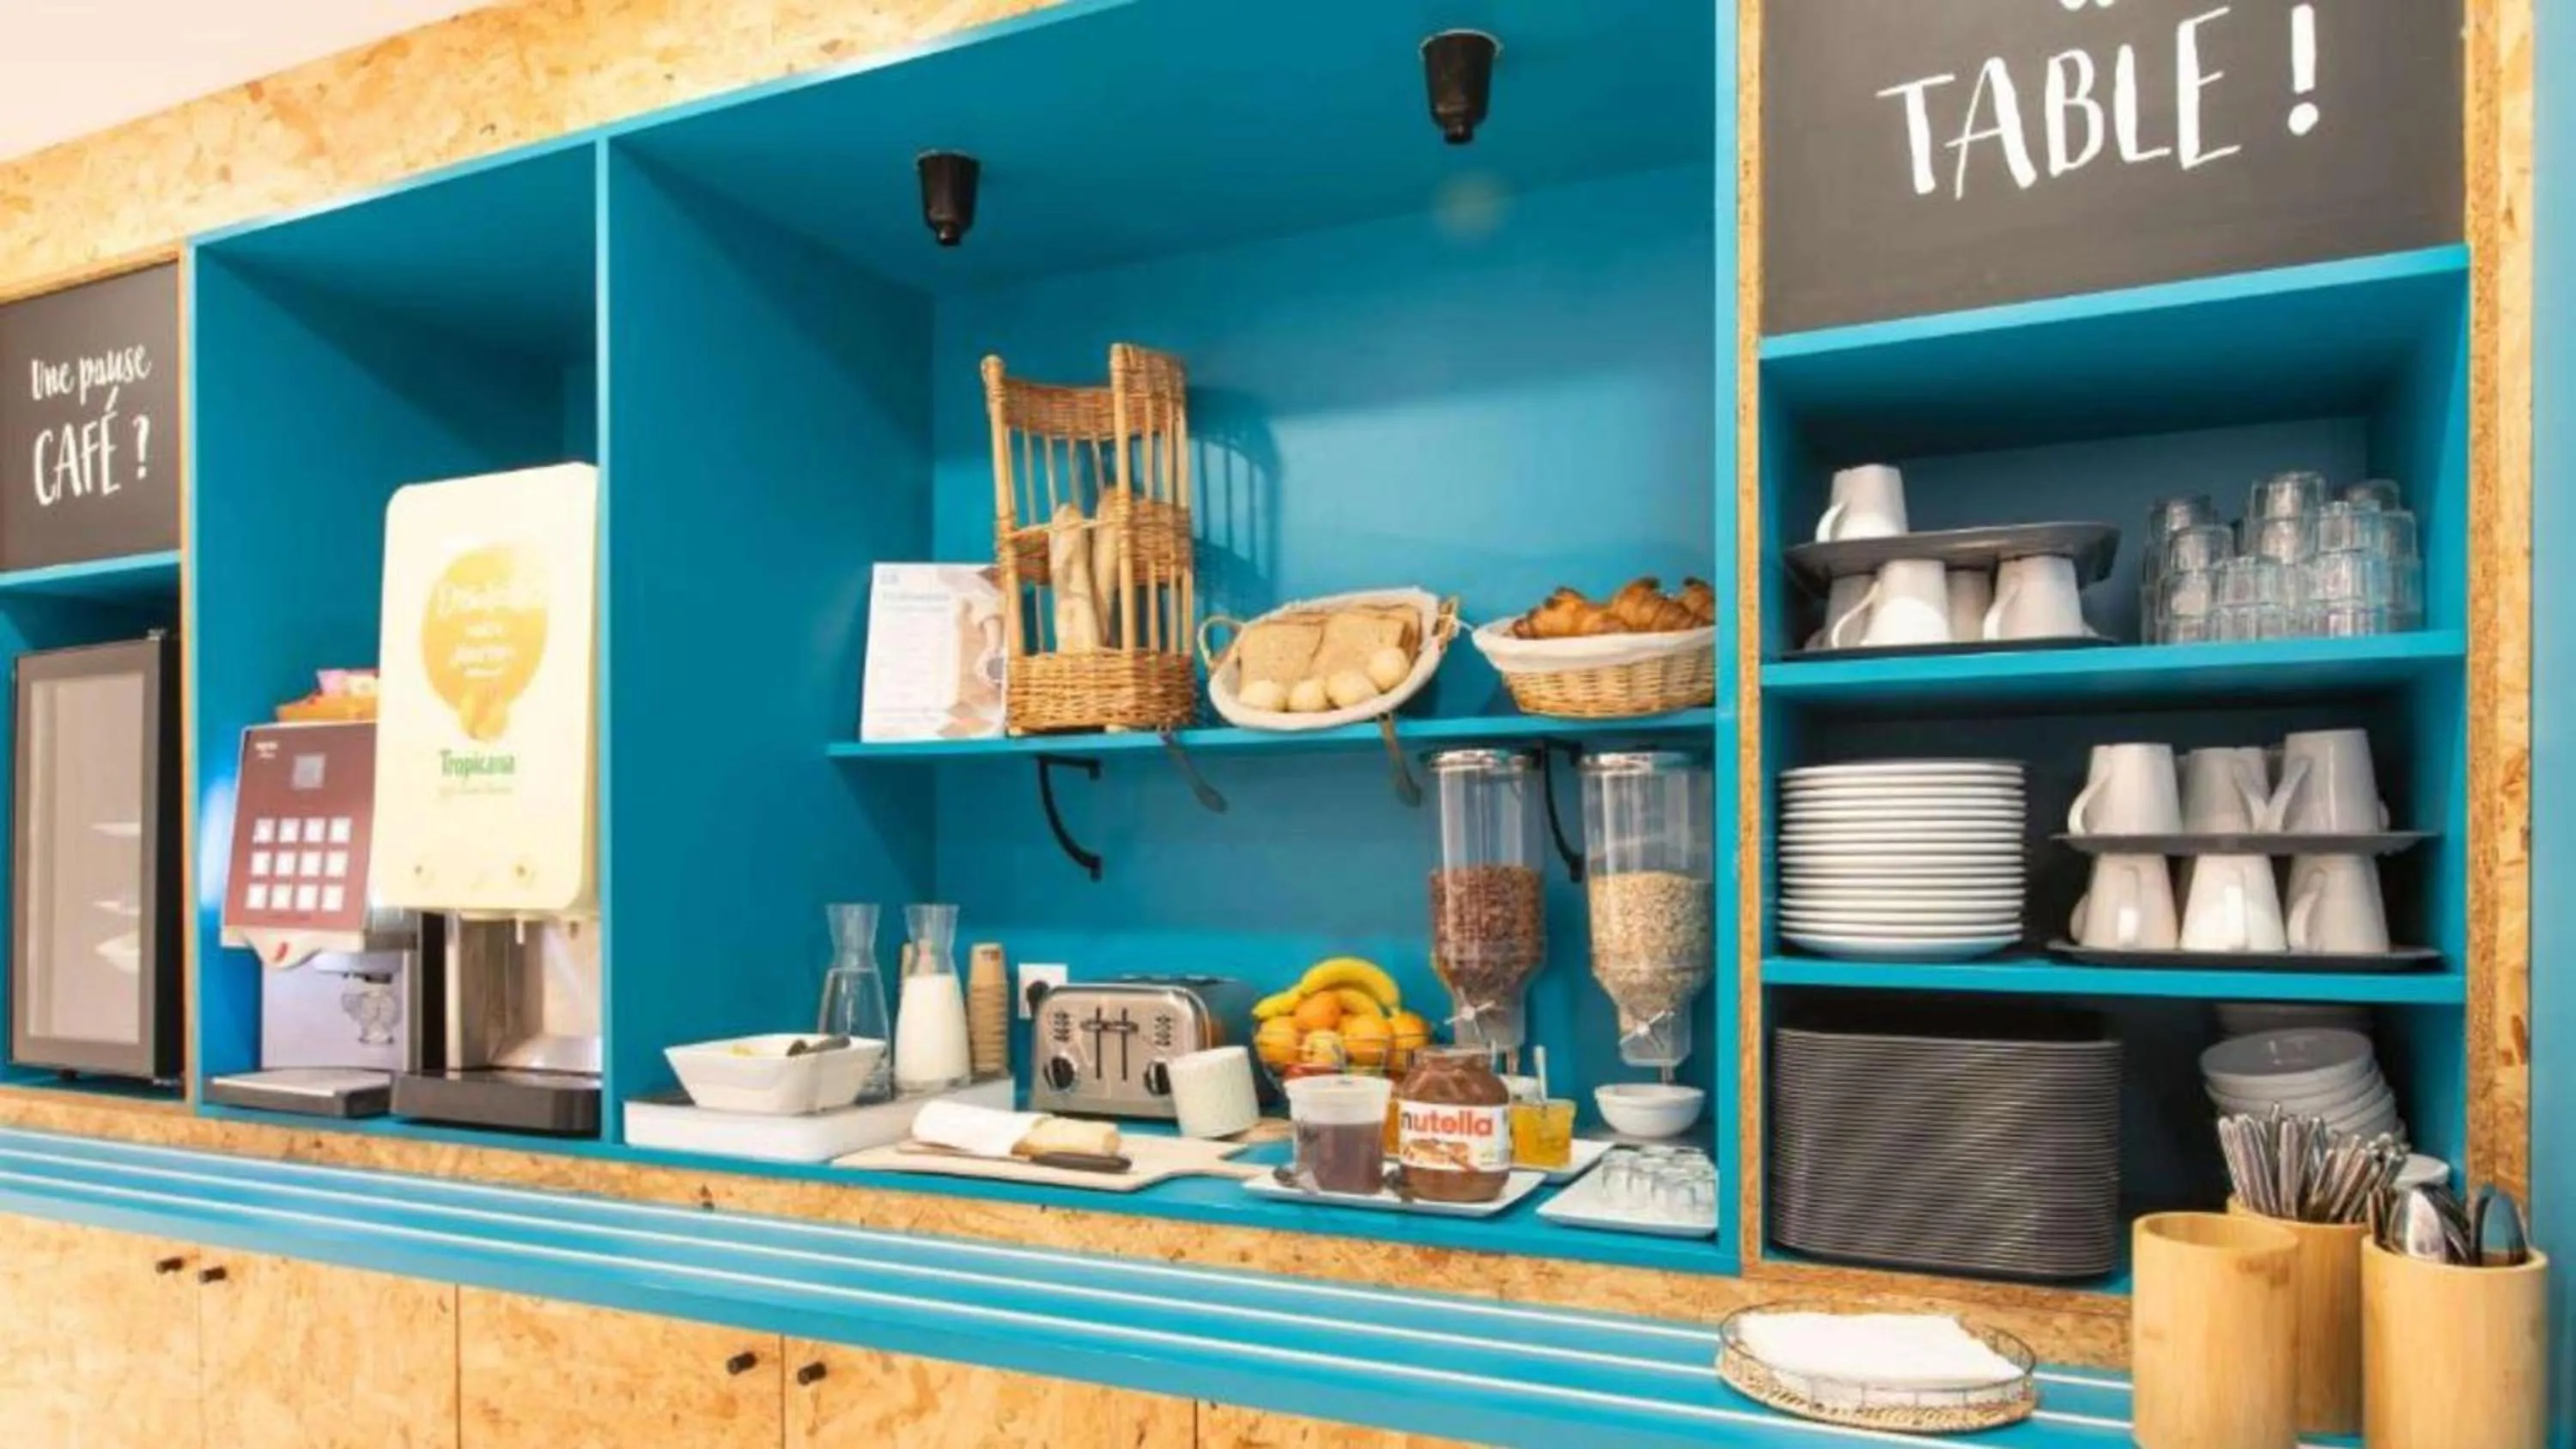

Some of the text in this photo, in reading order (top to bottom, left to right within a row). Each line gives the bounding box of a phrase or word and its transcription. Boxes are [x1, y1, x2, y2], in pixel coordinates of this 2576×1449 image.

[1875, 5, 2242, 200] TABLE
[31, 343, 152, 406] Une pause
[33, 385, 122, 506] CAFÉ
[438, 749, 517, 780] Tropicana
[1400, 1109, 1495, 1137] nutella
